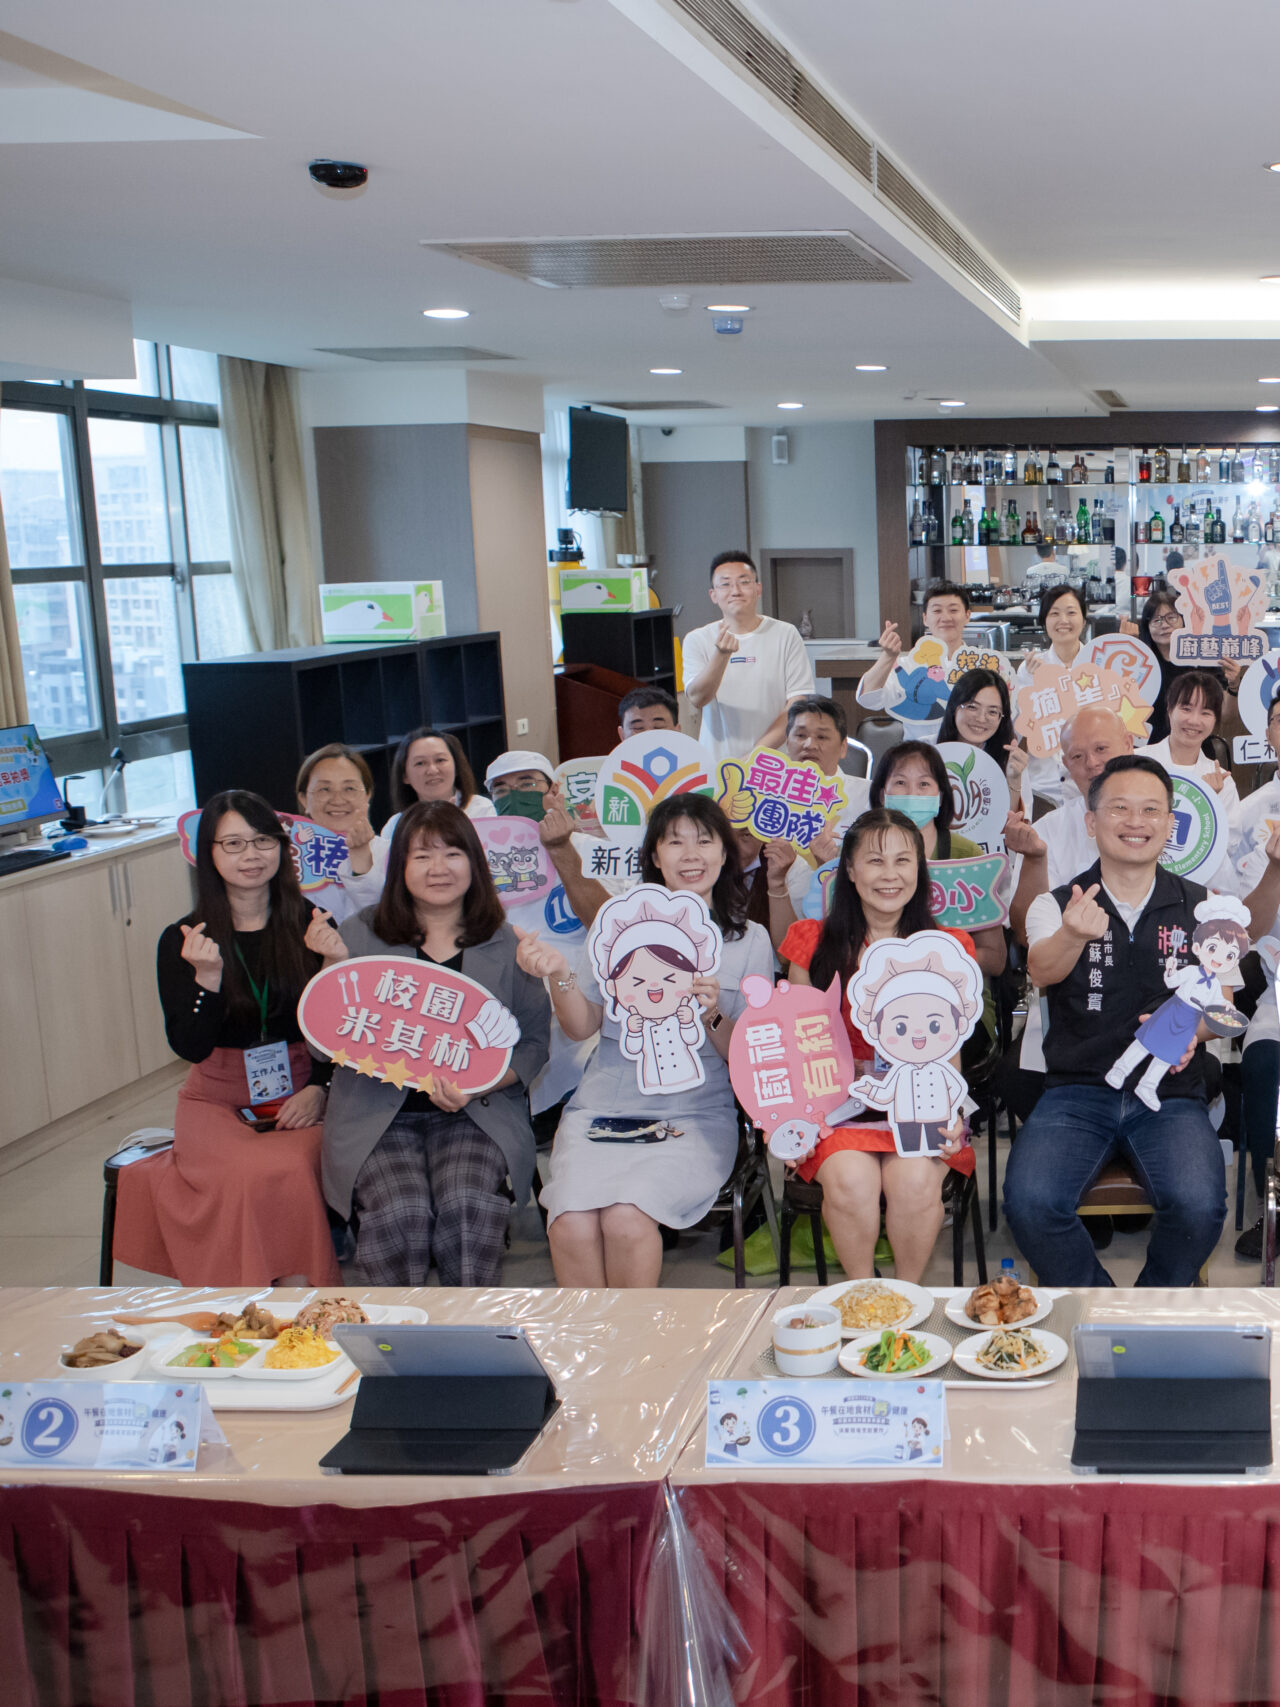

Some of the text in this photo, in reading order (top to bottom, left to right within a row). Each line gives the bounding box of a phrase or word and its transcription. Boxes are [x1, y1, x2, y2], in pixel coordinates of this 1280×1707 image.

[1212, 601, 1229, 610] BEST
[1178, 636, 1261, 658] 廚藝巔峰
[746, 752, 818, 804] 最佳
[754, 797, 823, 846] 團隊
[1174, 812, 1211, 873] Elementary School
[1103, 930, 1114, 967] 副市長
[373, 968, 465, 1024] 校園
[1086, 943, 1103, 1012] 蘇俊賓
[336, 1006, 473, 1073] 米其林
[745, 1022, 794, 1108] 廚神
[794, 1014, 842, 1100] 有約
[33, 1406, 64, 1447] 2
[772, 1405, 801, 1446] 3
